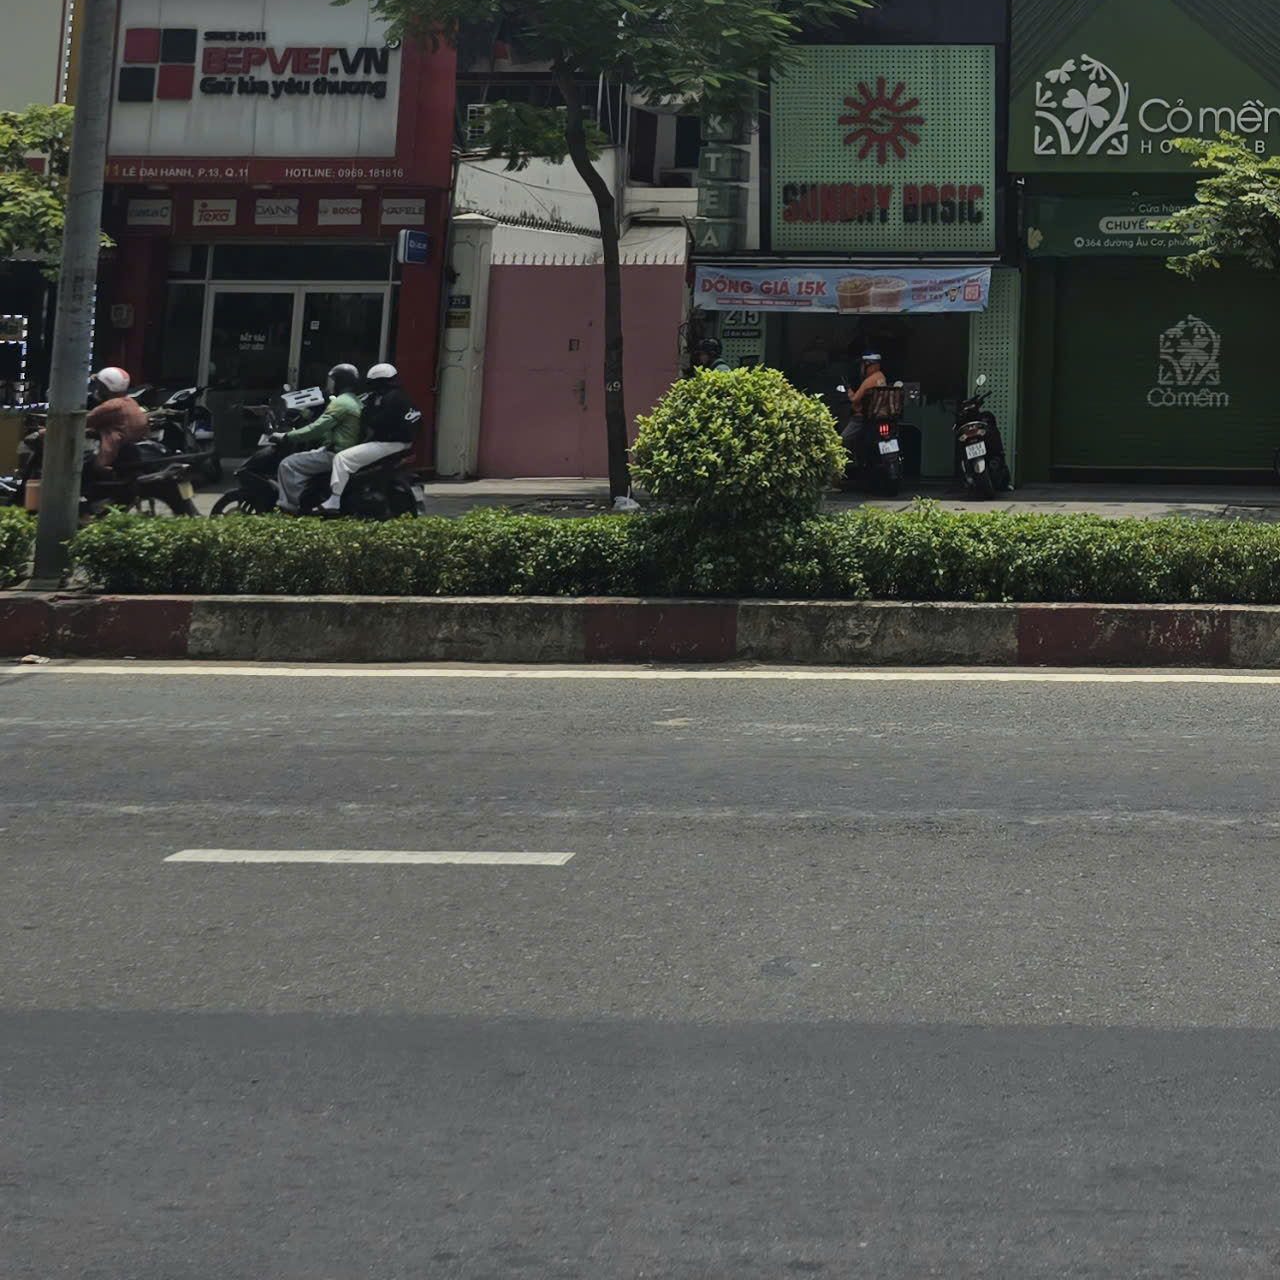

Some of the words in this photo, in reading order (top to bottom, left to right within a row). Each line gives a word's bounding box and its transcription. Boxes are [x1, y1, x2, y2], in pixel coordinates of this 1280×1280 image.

[1139, 98, 1193, 134] Cỏ
[285, 167, 335, 178] HOTLINE:
[903, 184, 985, 224] BASIC
[701, 275, 754, 295] ĐỒNG
[760, 276, 790, 296] GIÁ
[797, 281, 827, 296] 15K
